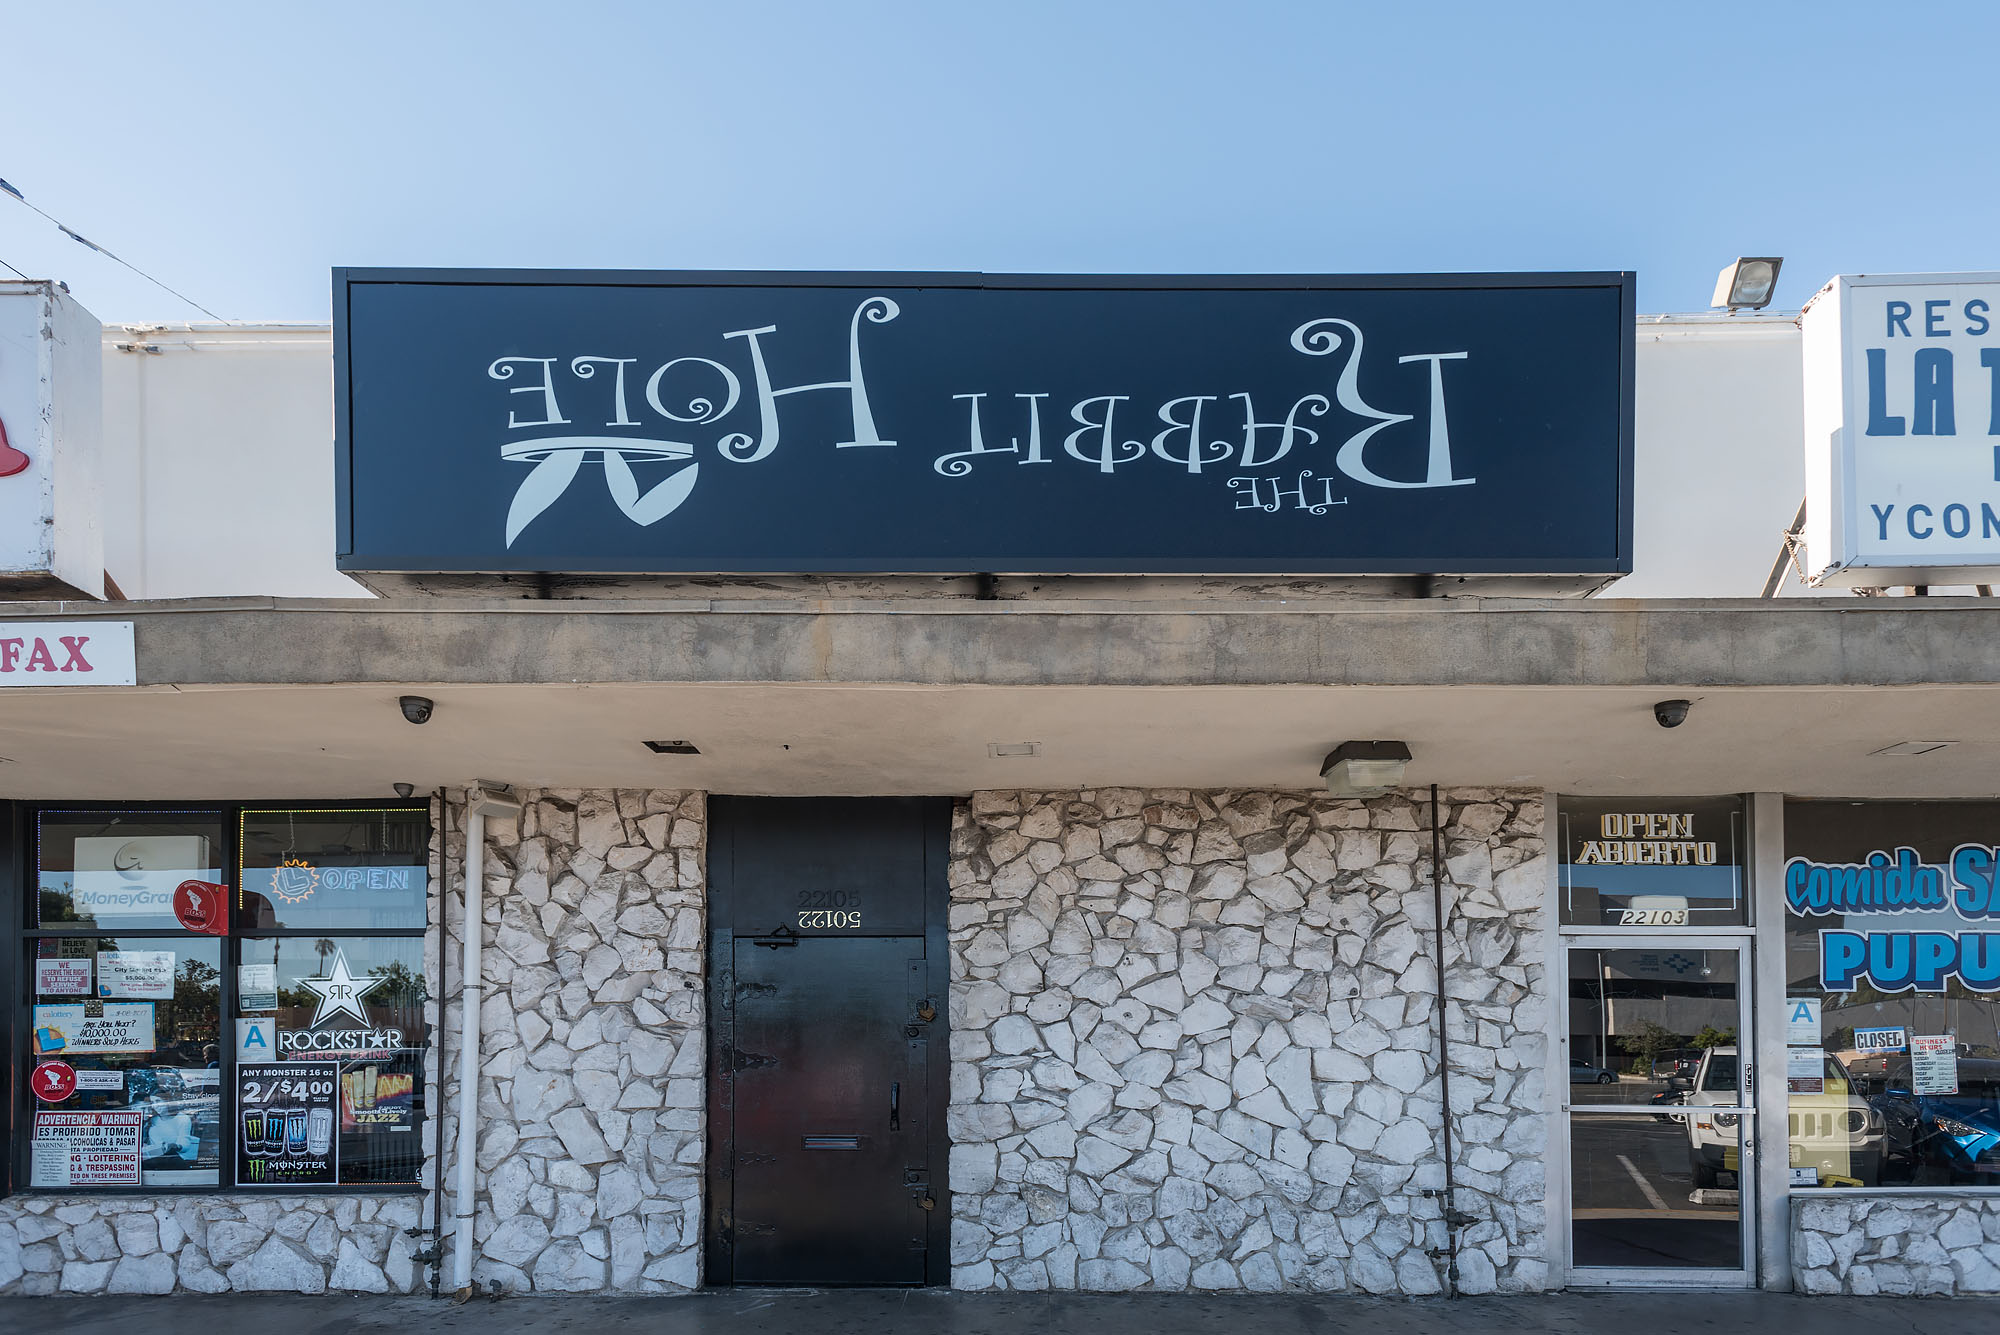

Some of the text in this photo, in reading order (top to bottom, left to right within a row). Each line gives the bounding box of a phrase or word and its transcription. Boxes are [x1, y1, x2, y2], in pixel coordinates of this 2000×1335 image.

[1886, 299, 1990, 337] RES
[1865, 347, 1957, 436] LA
[0, 636, 94, 673] FAX
[1601, 813, 1695, 838] OPEN
[1575, 840, 1717, 865] ABIERTO
[322, 868, 409, 890] OPEN
[82, 890, 174, 908] MoneyGra
[1621, 910, 1686, 925] 22103
[58, 961, 70, 969] WE
[1791, 1001, 1814, 1023] A
[243, 1025, 267, 1048] A
[1856, 1031, 1903, 1049] CLOSED
[288, 1049, 391, 1060] ENERGY DRINK
[242, 1069, 261, 1077] ANY
[356, 1113, 400, 1123] JAZZ
[39, 1127, 136, 1136] ES PROHIBIDO TOMAR
[115, 1137, 136, 1146] PASAR
[88, 1154, 136, 1162] LOITERING
[268, 1160, 327, 1171] MONSTER
